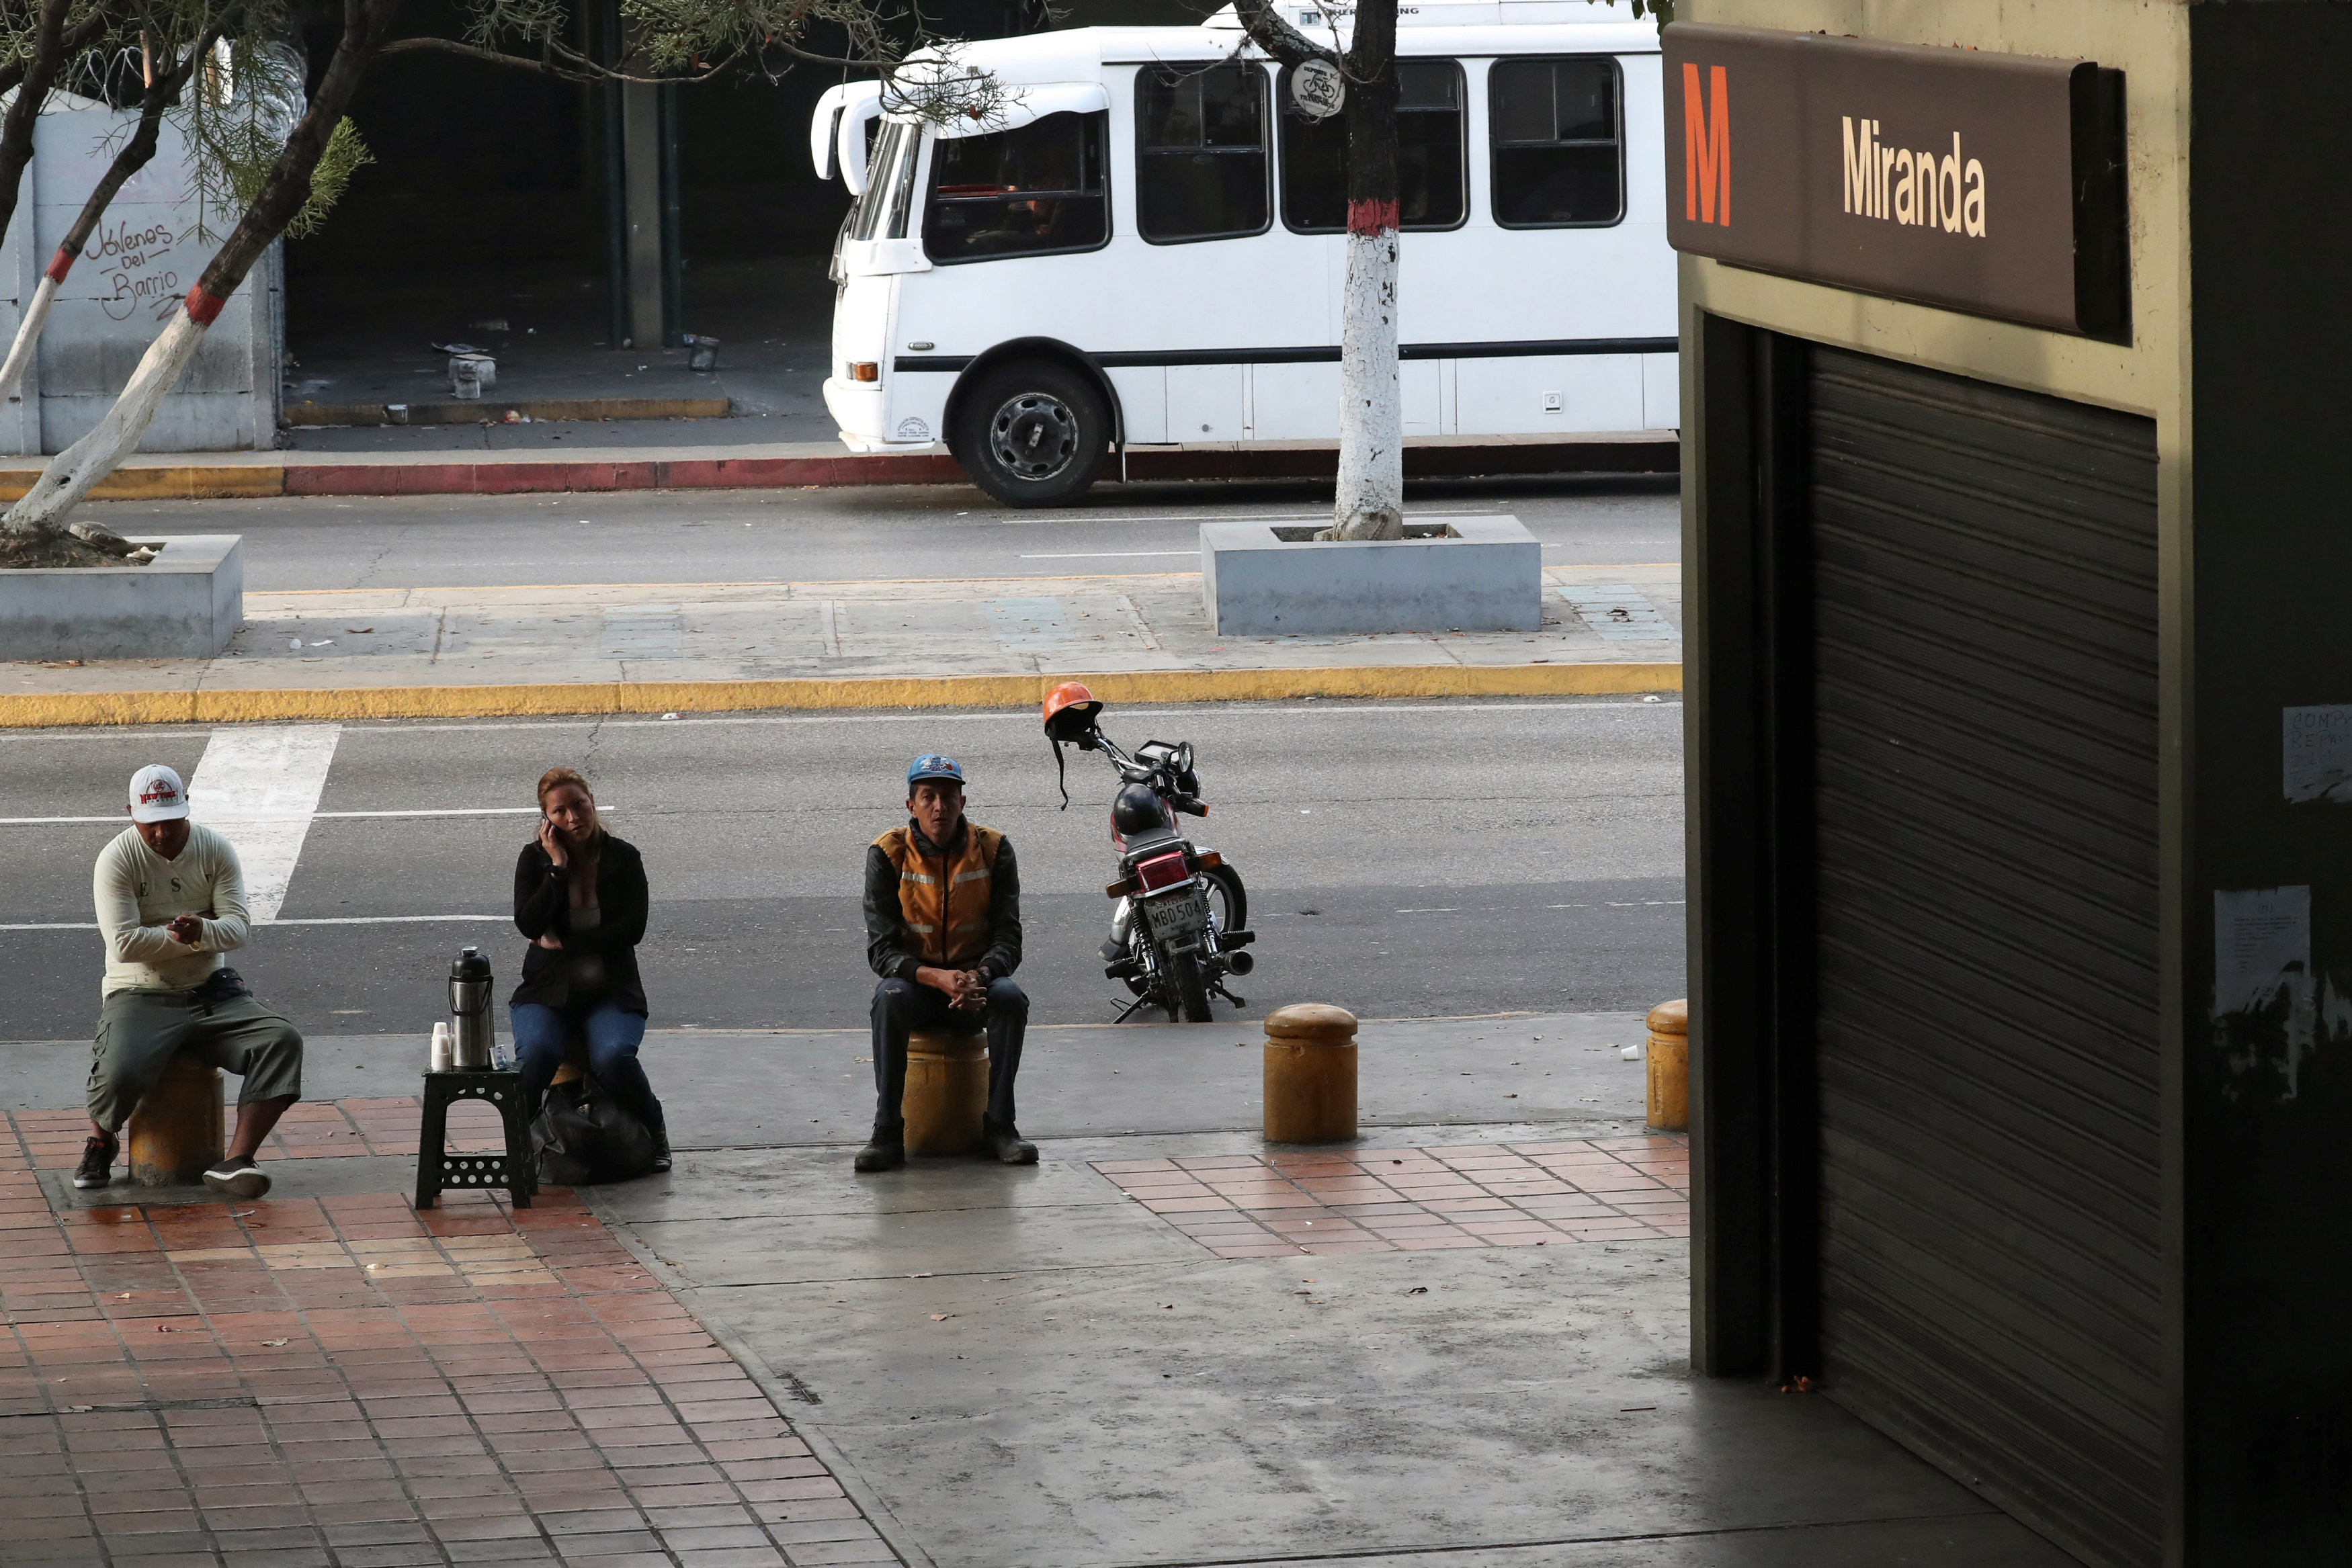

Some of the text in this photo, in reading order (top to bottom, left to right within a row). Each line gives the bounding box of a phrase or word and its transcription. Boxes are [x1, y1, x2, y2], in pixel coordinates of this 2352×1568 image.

[1683, 62, 1730, 226] M
[1843, 116, 1986, 238] Miranda
[101, 271, 177, 320] Barrio
[139, 793, 158, 804] NEW
